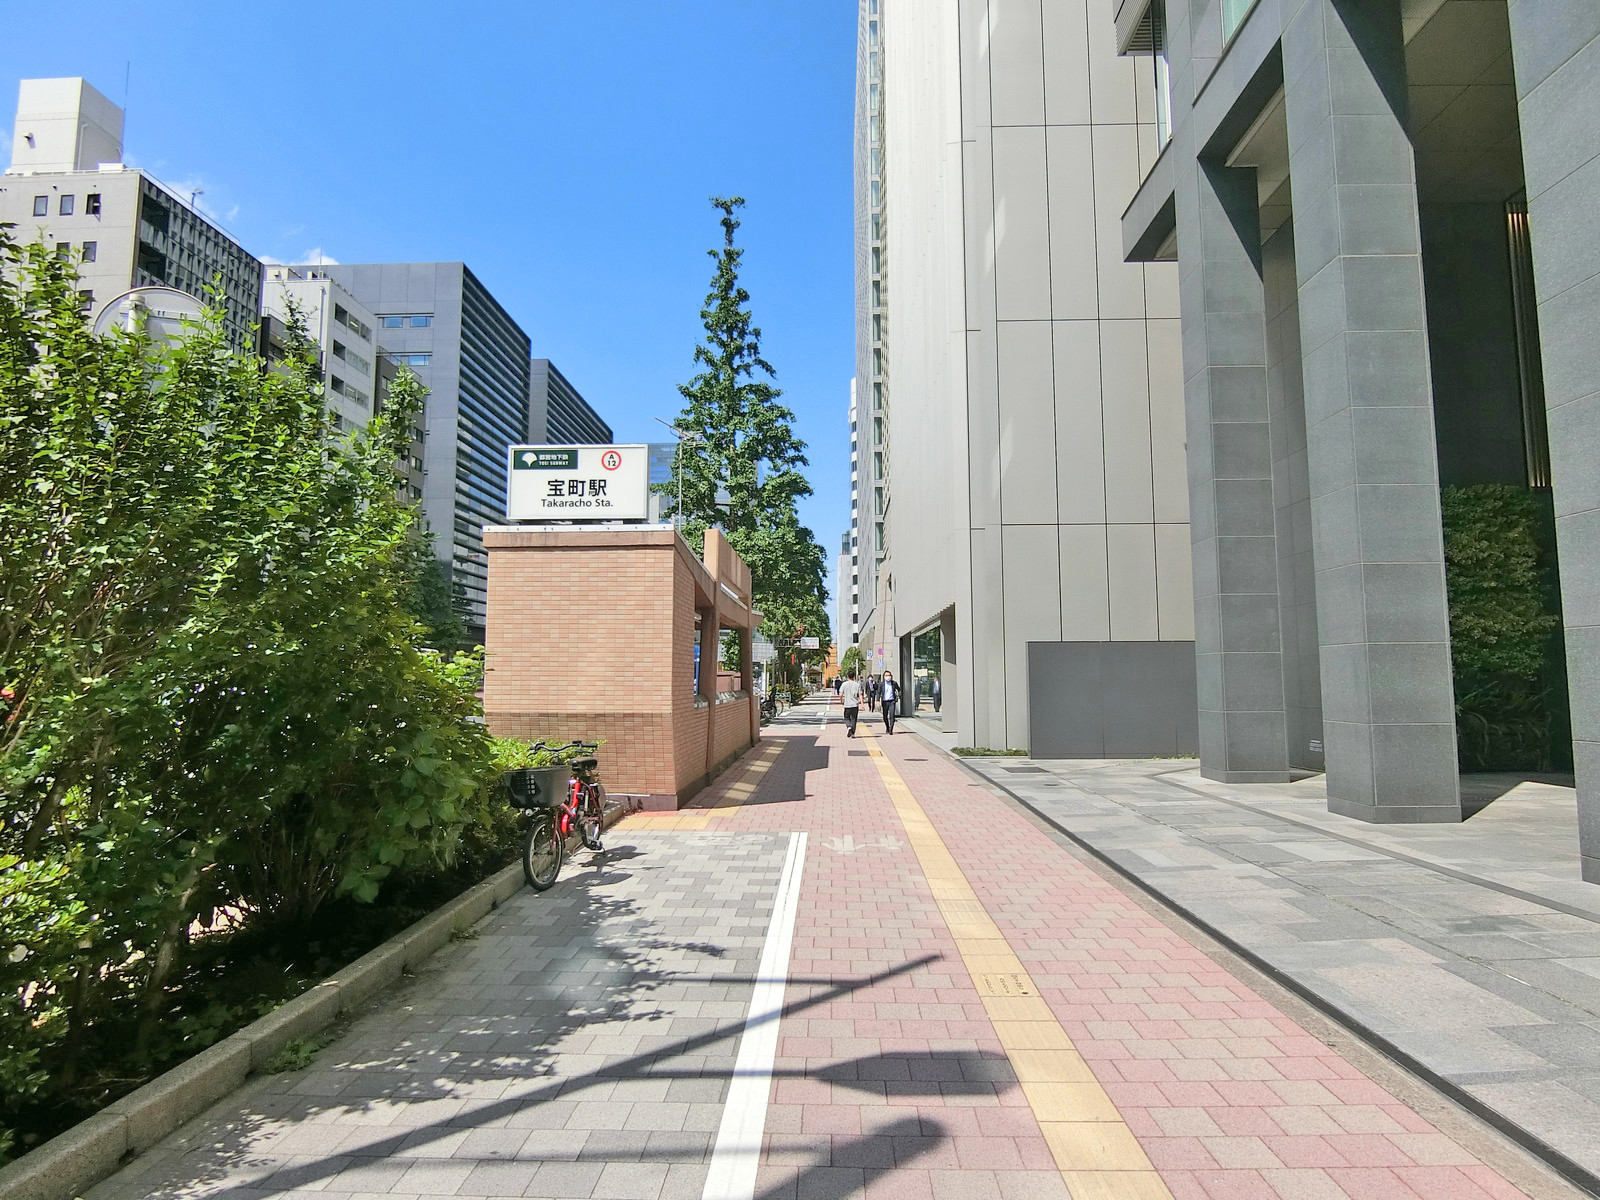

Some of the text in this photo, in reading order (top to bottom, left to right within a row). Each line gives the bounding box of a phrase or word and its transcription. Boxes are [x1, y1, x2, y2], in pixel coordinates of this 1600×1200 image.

[547, 479, 607, 497] 宝町駅
[541, 499, 613, 507] Takaracho Sta.
